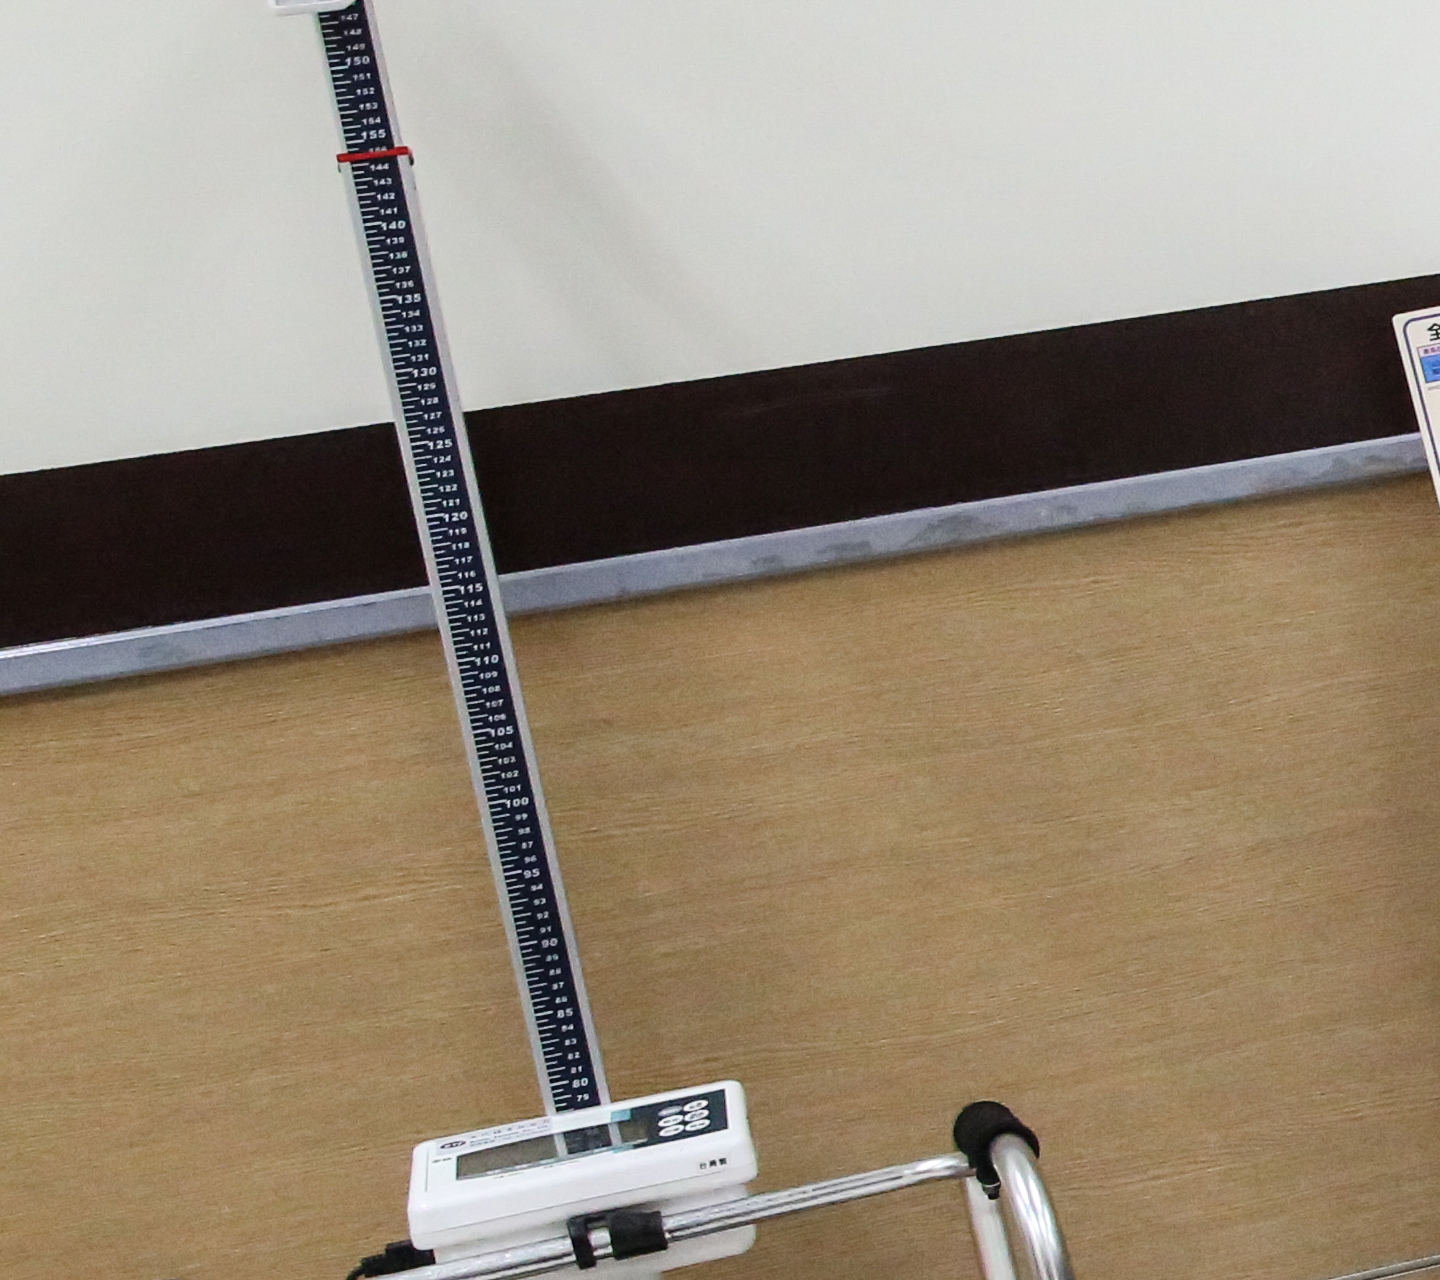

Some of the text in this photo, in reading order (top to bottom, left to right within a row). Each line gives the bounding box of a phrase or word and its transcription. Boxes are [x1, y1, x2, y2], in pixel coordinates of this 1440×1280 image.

[345, 55, 370, 66] 150
[362, 129, 386, 140] 155
[382, 220, 406, 231] 140
[397, 293, 422, 304] 135
[412, 367, 437, 377] 130
[429, 439, 453, 450] 125
[444, 511, 468, 522] 120
[459, 583, 484, 594] 115
[475, 655, 500, 665] 110
[490, 726, 514, 736] 105
[505, 797, 530, 807] 100
[524, 868, 540, 878] 95
[541, 938, 558, 948] 90
[557, 1008, 573, 1018] 85
[572, 1078, 588, 1088] 80
